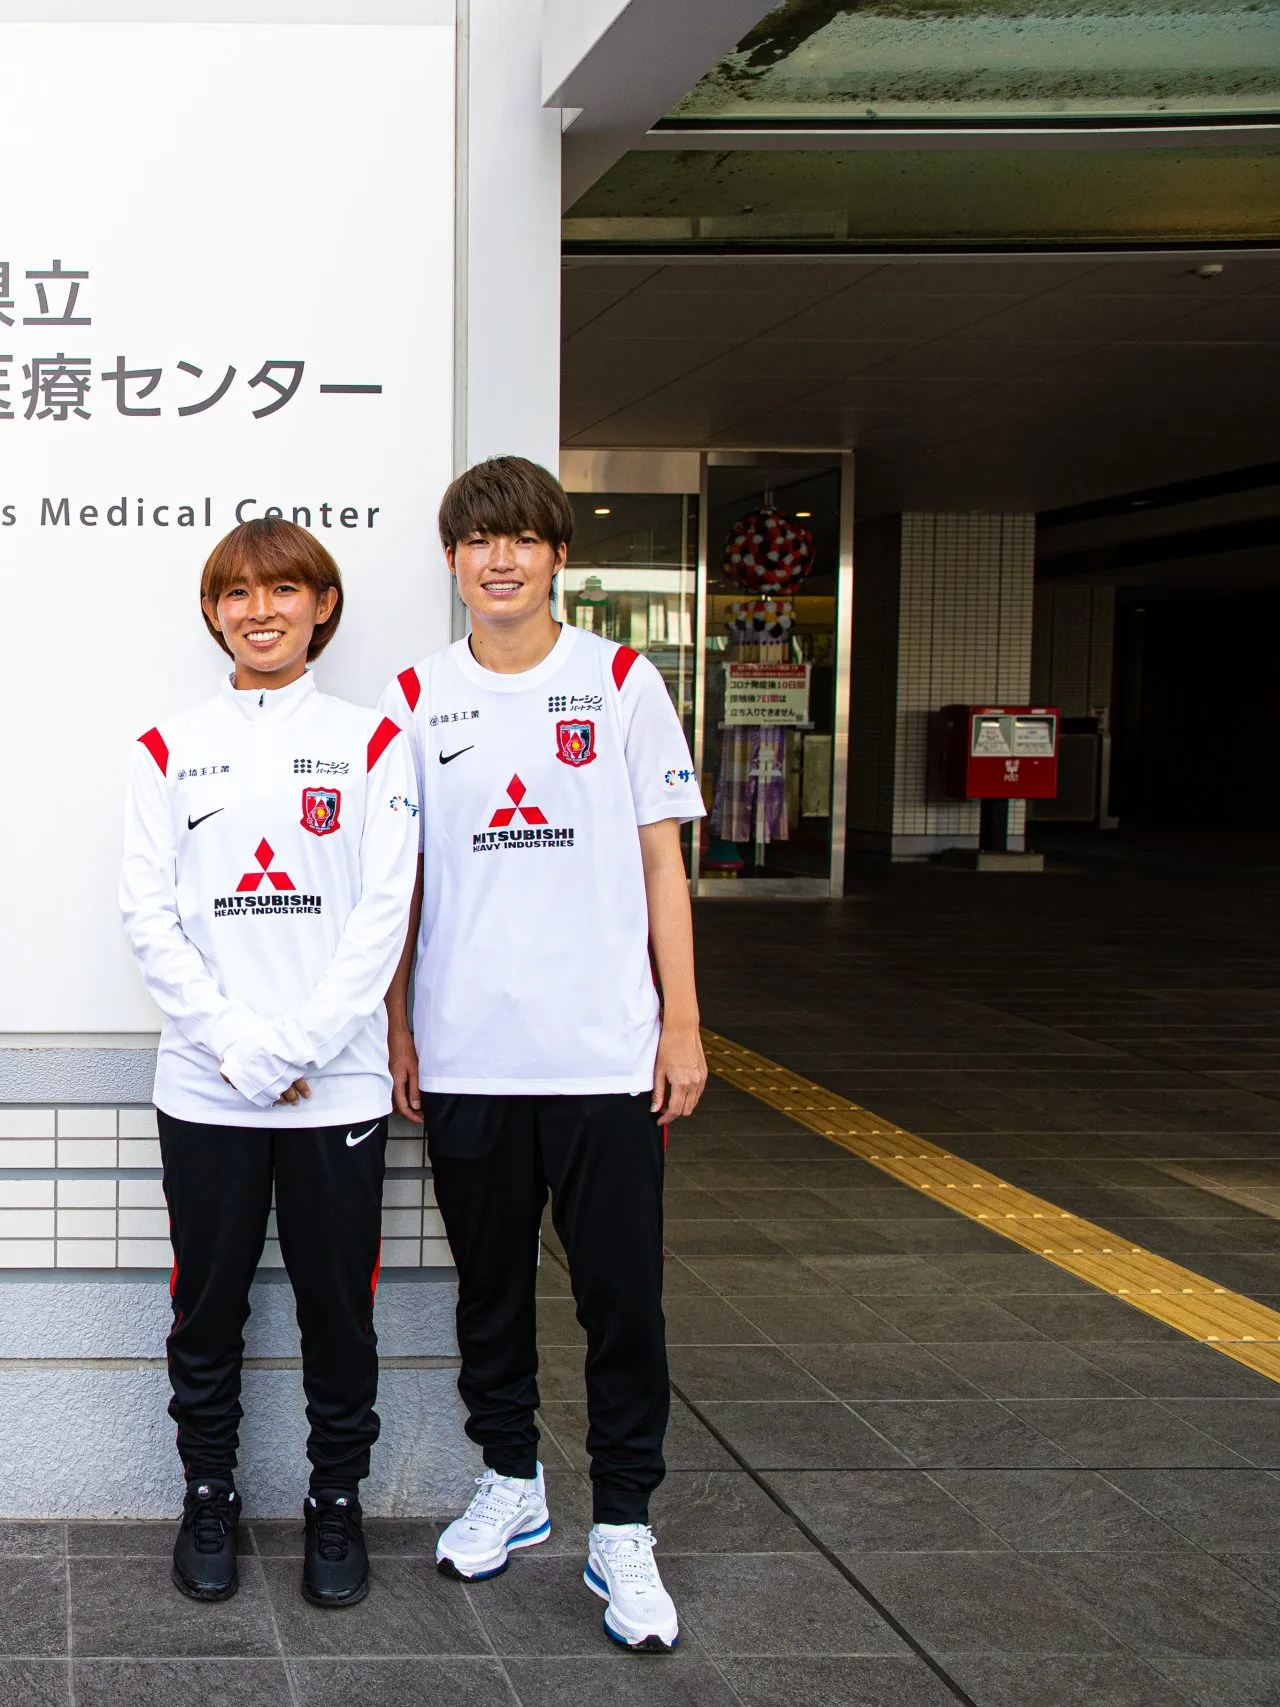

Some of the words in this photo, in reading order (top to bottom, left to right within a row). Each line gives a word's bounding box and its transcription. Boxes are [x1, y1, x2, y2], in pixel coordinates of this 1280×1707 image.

[40, 496, 211, 527] Medical
[235, 498, 380, 528] Center
[570, 695, 602, 704] トーシン
[316, 760, 350, 769] トーシン
[473, 828, 575, 845] MITSUBISHI
[504, 840, 575, 849] INDUSTRIES
[214, 895, 322, 909] MITSUBISHI
[214, 908, 248, 918] HEAVY
[251, 906, 322, 915] INDUSTRIES
